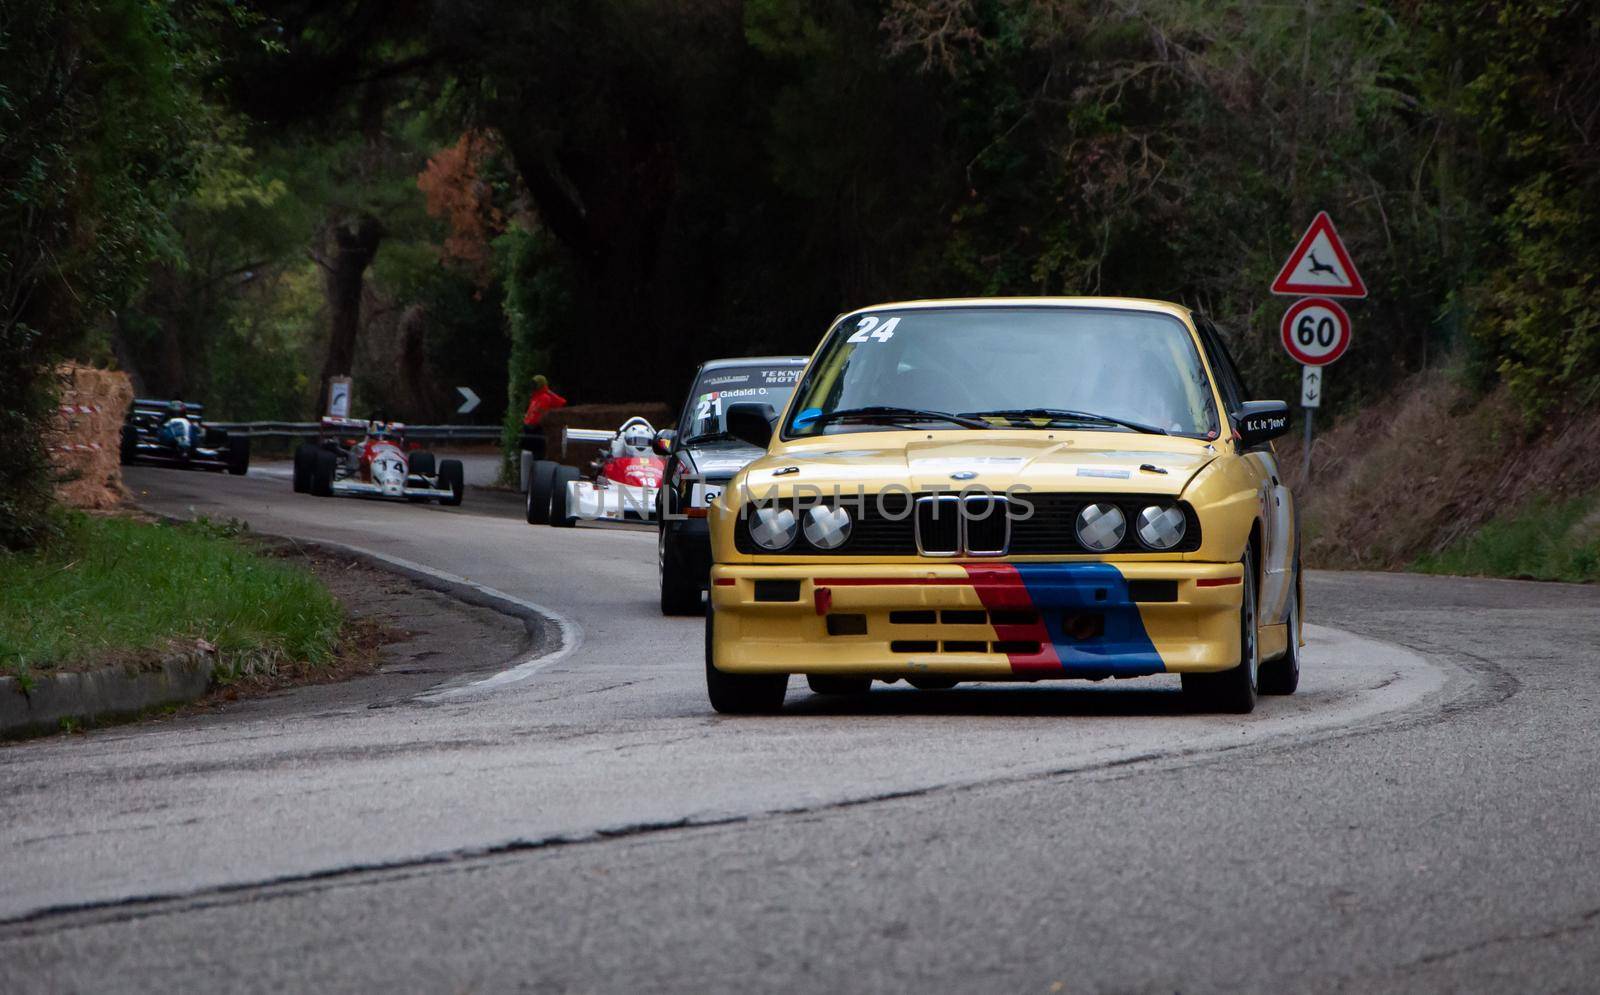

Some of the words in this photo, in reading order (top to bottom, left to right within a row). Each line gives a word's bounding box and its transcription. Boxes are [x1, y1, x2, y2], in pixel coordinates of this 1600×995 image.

[847, 316, 902, 343] 24
[1297, 315, 1335, 347] 60
[720, 387, 756, 399] Gadaldi
[758, 387, 769, 396] O.
[697, 397, 722, 420] 21
[379, 459, 405, 474] 14
